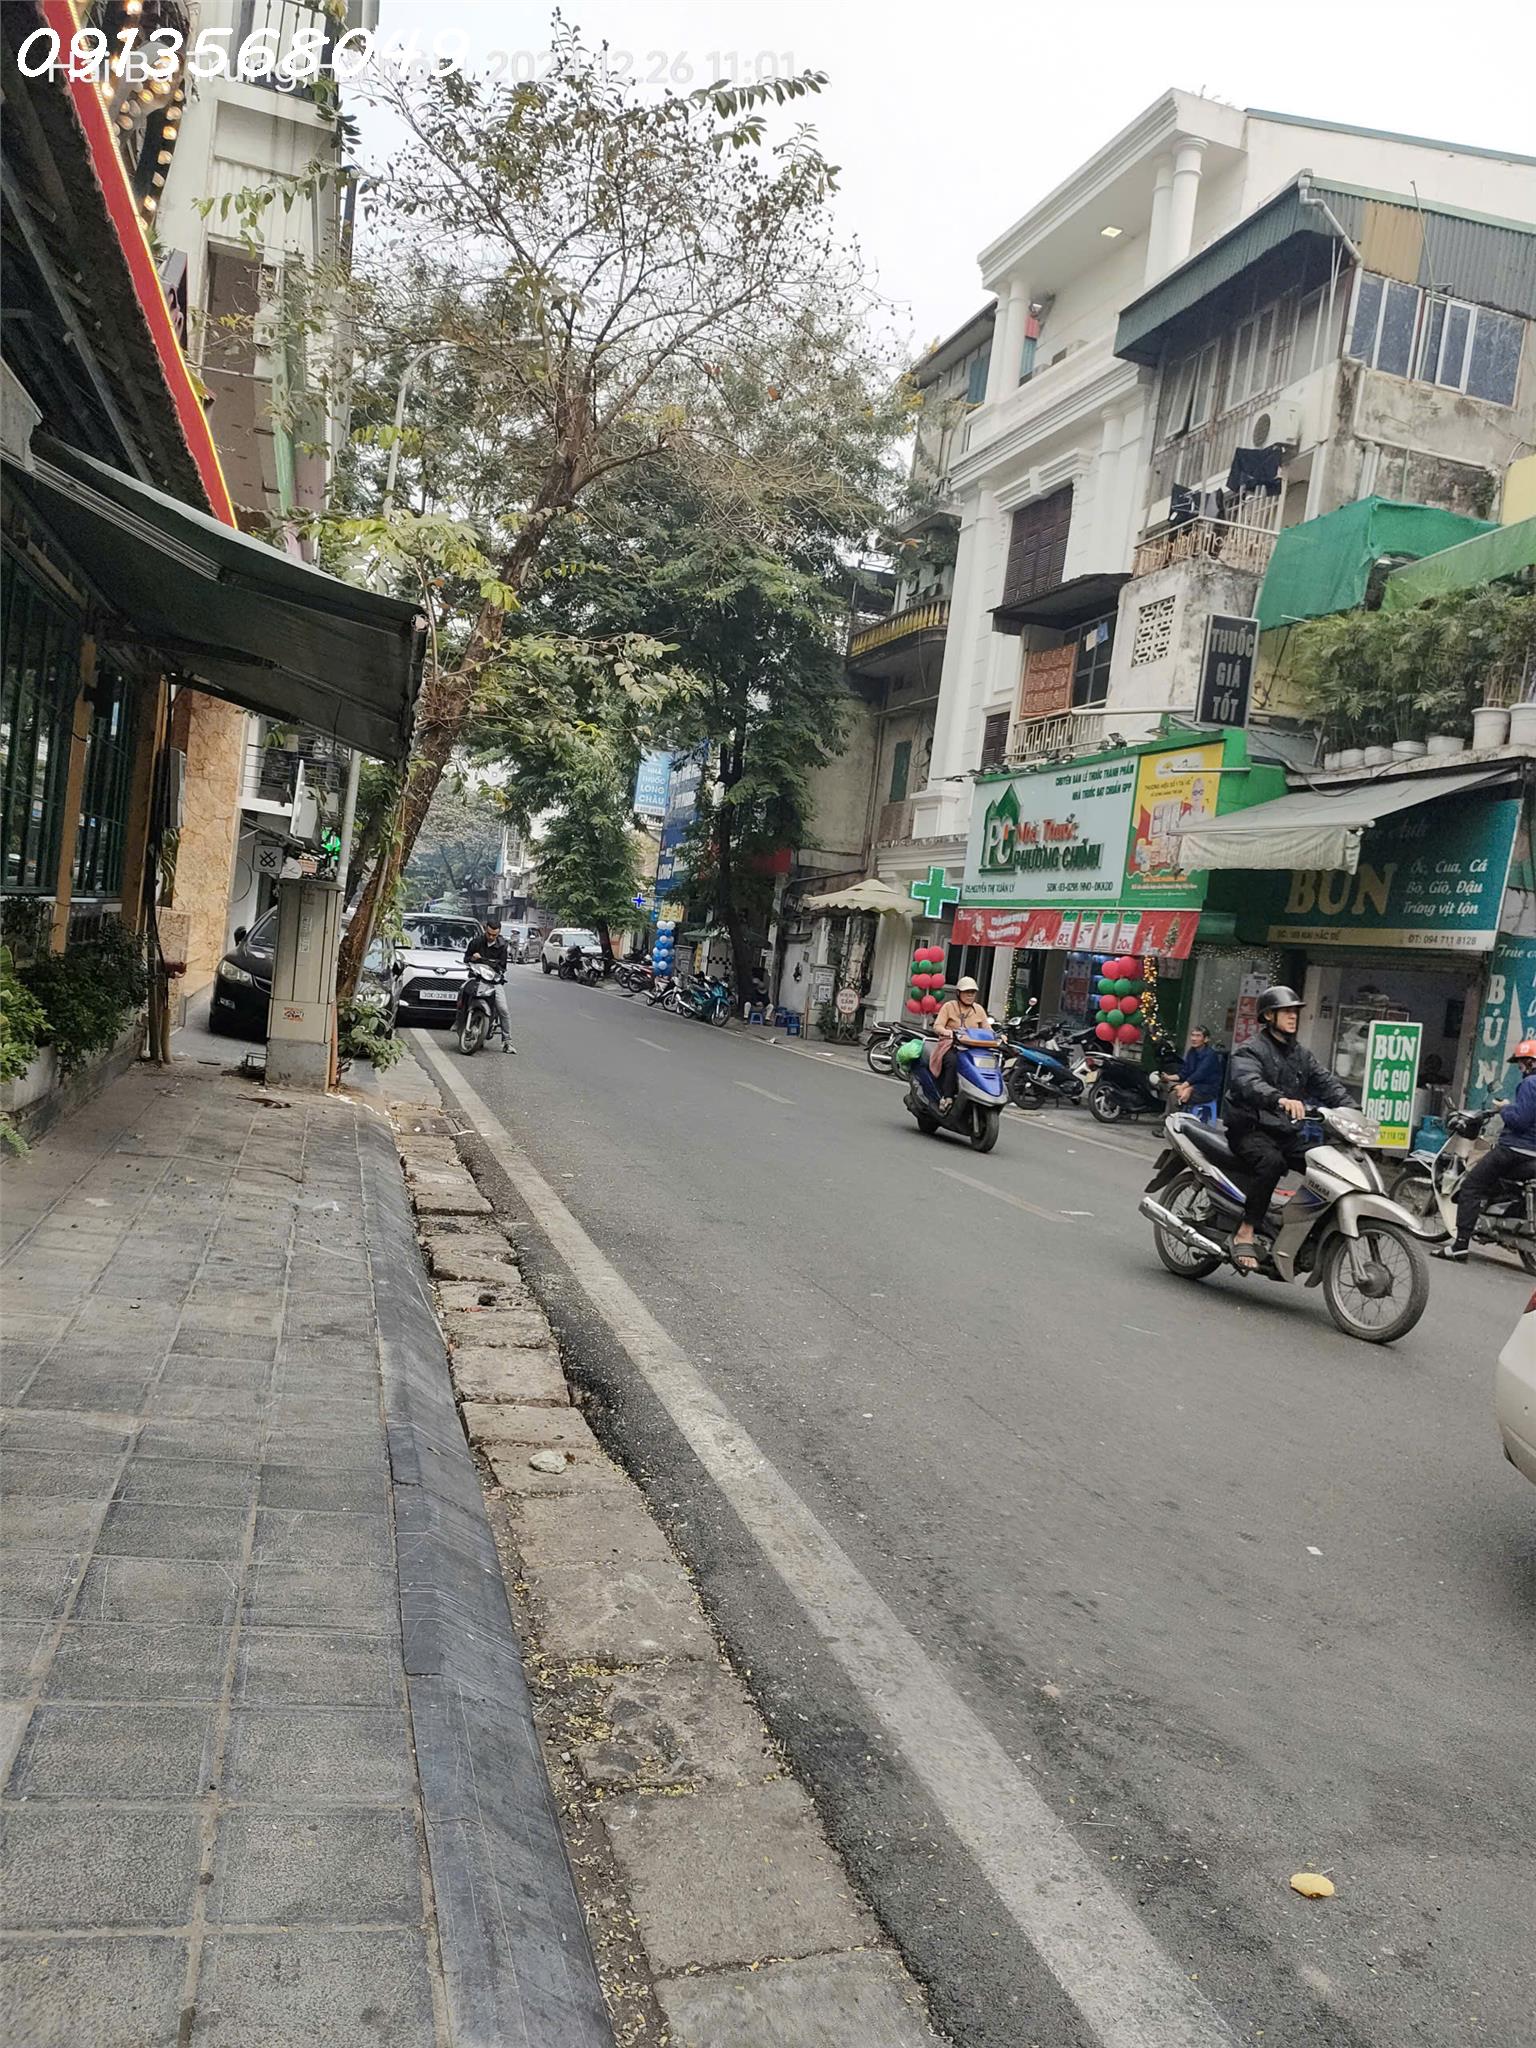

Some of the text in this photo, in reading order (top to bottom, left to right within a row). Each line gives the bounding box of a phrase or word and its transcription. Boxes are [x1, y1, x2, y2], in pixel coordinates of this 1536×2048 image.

[1211, 625, 1254, 657] THUỐC
[1215, 659, 1241, 688] GIÁ
[1213, 689, 1239, 722] TỐT
[1435, 860, 1462, 874] Cua,
[1469, 857, 1489, 874] Cá
[1455, 880, 1484, 897] Đậu
[1438, 901, 1456, 917] vịt
[1456, 901, 1480, 917] lộn
[1373, 1028, 1418, 1062] BÚN
[1372, 1061, 1411, 1092] ỐC GIÒ
[1367, 1094, 1411, 1122] RIÊU BÒ
